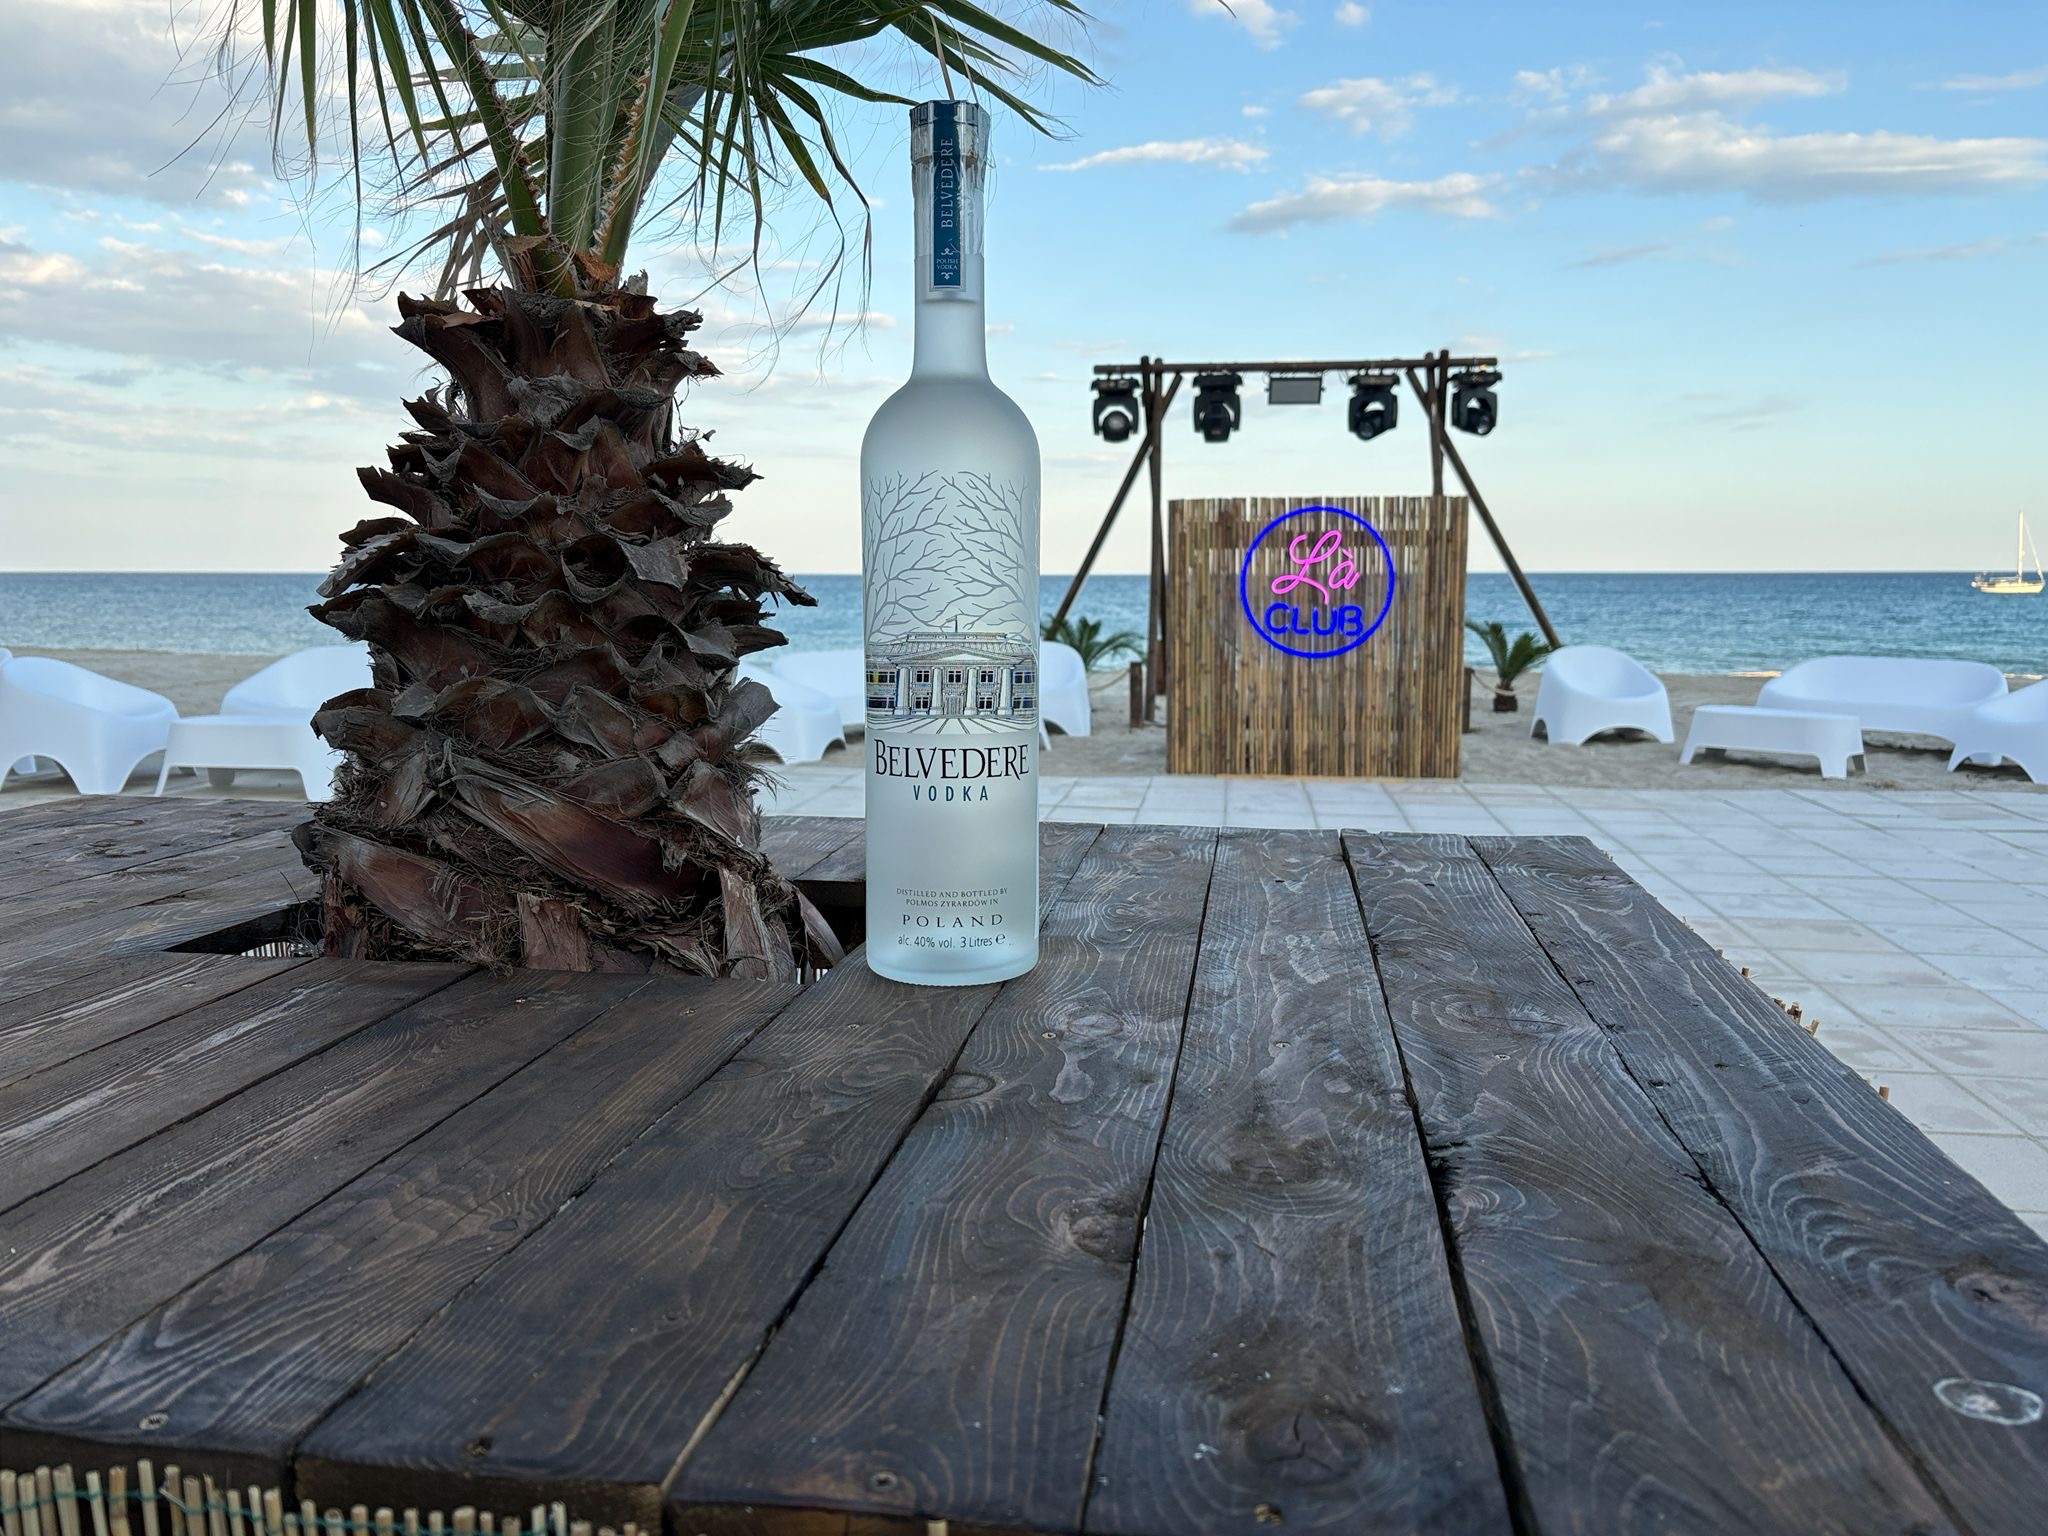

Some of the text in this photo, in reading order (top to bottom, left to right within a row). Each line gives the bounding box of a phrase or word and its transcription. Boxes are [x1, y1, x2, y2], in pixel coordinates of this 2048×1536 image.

[941, 138, 953, 228] BELVEDERE
[1271, 529, 1361, 605] Là
[1265, 602, 1363, 636] CLUB
[874, 738, 1030, 781] BELVEDERE
[913, 785, 989, 801] VODKA
[896, 887, 1008, 898] DISTILLED AND BOTTLED BY
[906, 898, 938, 907] POLMOS
[902, 913, 1003, 928] POLAND
[898, 934, 912, 946] alc.
[914, 936, 935, 948] 40%
[938, 937, 955, 949] vol.
[960, 937, 967, 948] 3
[969, 936, 992, 947] Litres
